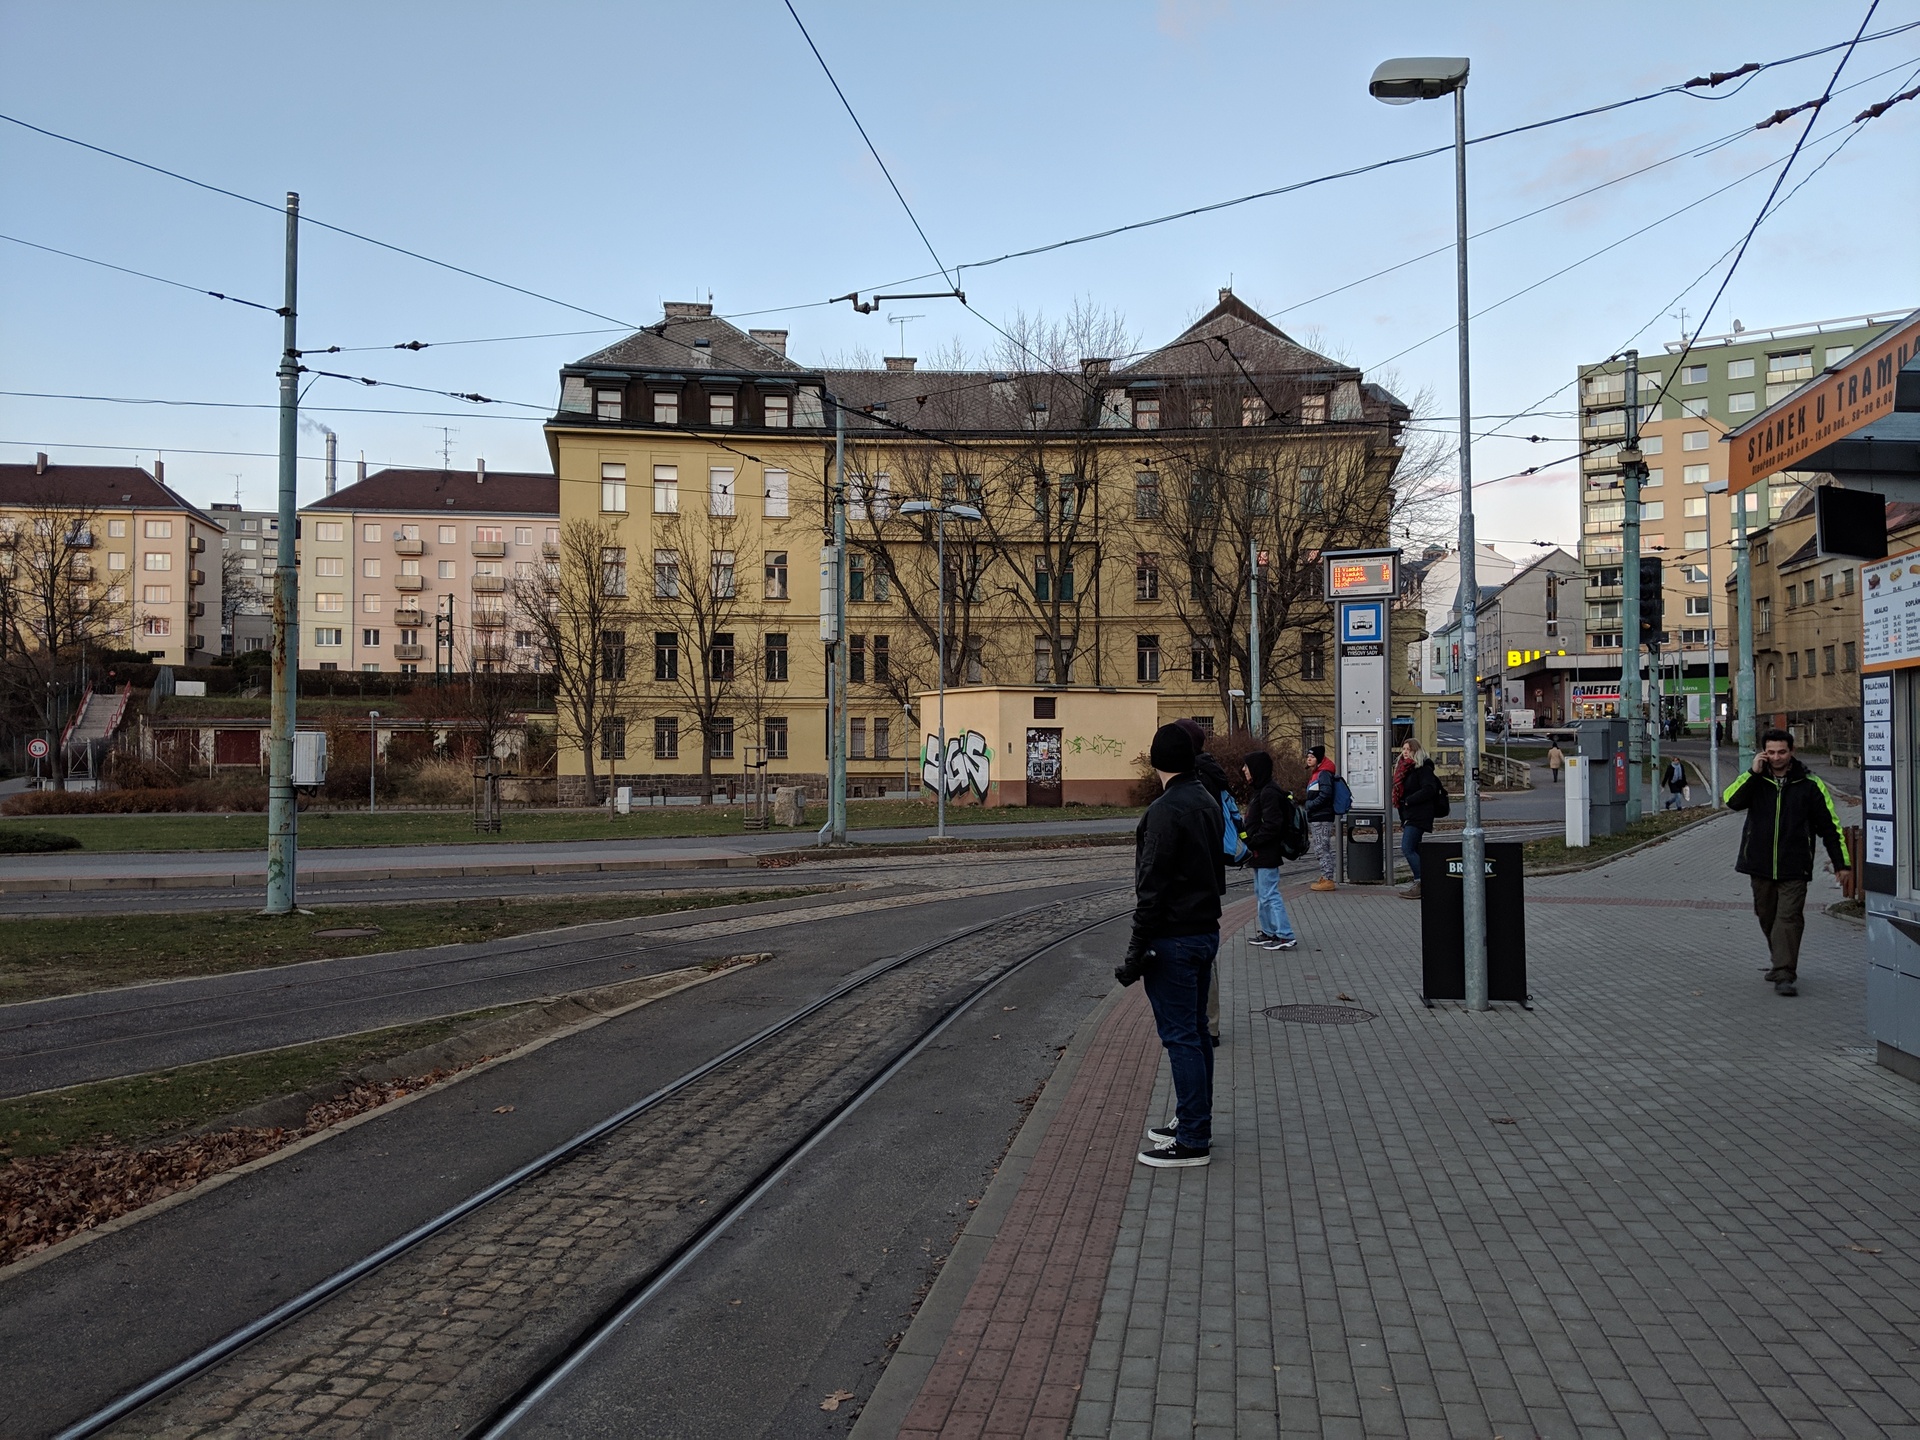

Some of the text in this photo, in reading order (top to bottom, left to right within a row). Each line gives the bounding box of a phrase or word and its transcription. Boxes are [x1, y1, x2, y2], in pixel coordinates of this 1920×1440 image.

[1748, 405, 1805, 462] STÁNEK
[1817, 394, 1825, 424] U
[1865, 681, 1889, 690] PALAČINKA
[1868, 730, 1884, 739] SEKANÁ
[1870, 774, 1884, 782] PÁREK
[1868, 786, 1888, 795] ROHLÍKU
